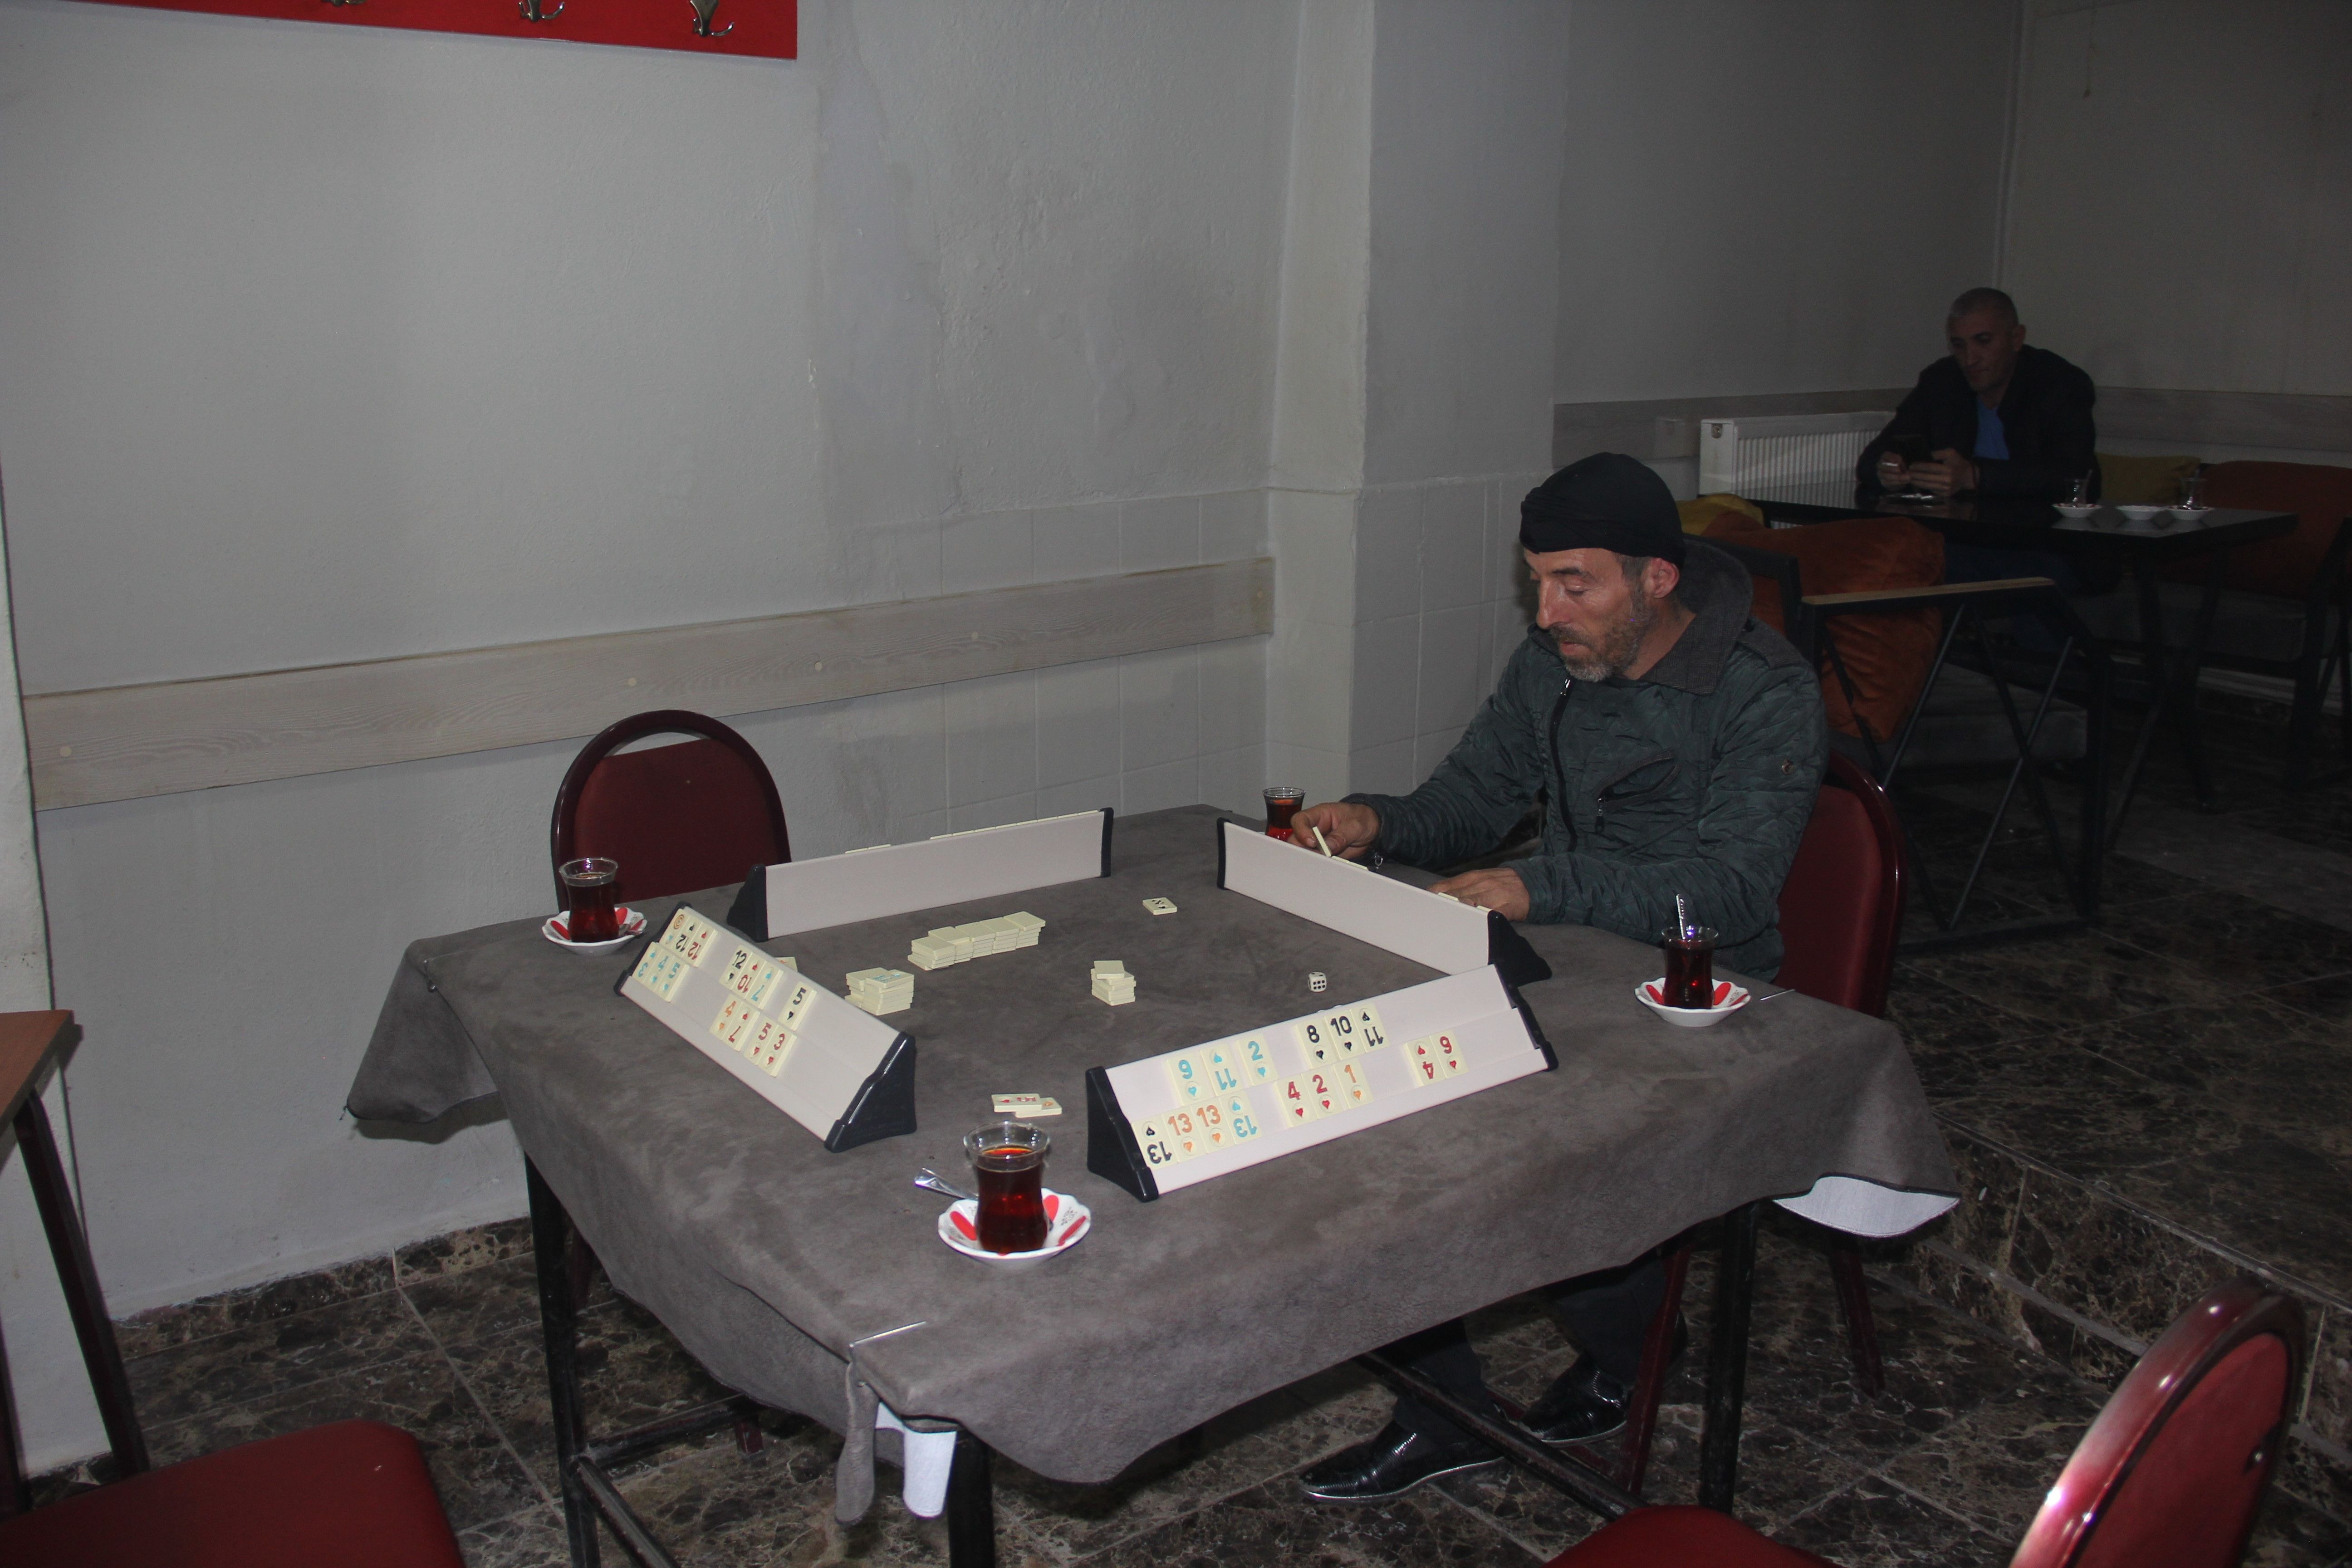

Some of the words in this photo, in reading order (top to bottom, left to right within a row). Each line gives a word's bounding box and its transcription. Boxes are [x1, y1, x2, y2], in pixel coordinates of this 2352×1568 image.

[676, 934, 689, 952] 12
[687, 942, 701, 960] 12
[658, 956, 668, 971] 4
[732, 950, 747, 969] 12
[638, 962, 648, 977] 3
[668, 962, 680, 978] 5
[737, 975, 752, 993] 10
[751, 985, 764, 1001] 7
[793, 987, 806, 1005] 5
[725, 1001, 736, 1017] 4
[728, 1026, 741, 1043] 7
[758, 1023, 772, 1040] 5
[1306, 1025, 1320, 1043] 8
[1330, 1015, 1352, 1036] 10
[774, 1033, 785, 1050] 3
[1364, 1026, 1383, 1047] 11
[1440, 1036, 1452, 1054] 9
[1248, 1041, 1263, 1061] 2
[1178, 1059, 1193, 1079] 9
[1344, 1064, 1356, 1083] 1
[1422, 1061, 1434, 1079] 4
[1215, 1068, 1237, 1090] 11
[1312, 1074, 1328, 1094] 2
[1288, 1081, 1301, 1100] 4
[1168, 1113, 1192, 1136] 13
[1196, 1105, 1221, 1127] 13
[1233, 1115, 1258, 1138] 13
[1147, 1141, 1172, 1164] 13
